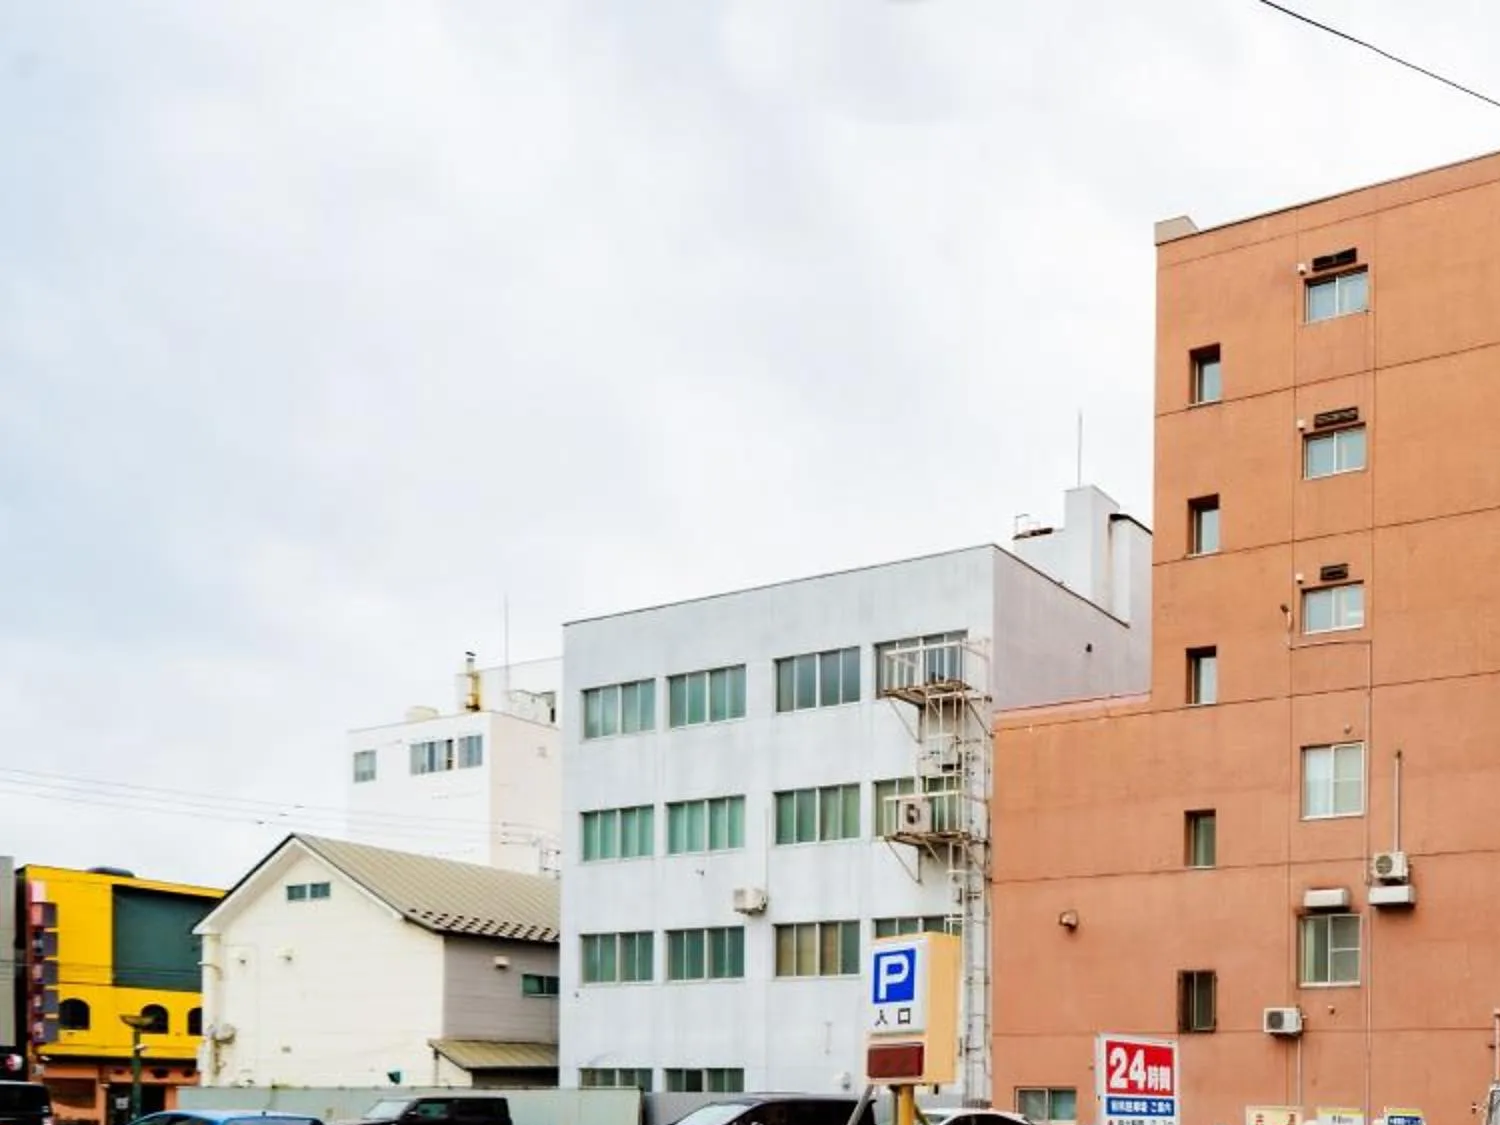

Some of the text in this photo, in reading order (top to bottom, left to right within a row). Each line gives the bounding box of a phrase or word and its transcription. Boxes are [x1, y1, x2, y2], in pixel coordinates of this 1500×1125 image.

[878, 953, 910, 1000] P
[875, 1007, 911, 1026] 入口
[1109, 1046, 1171, 1091] 24時間
